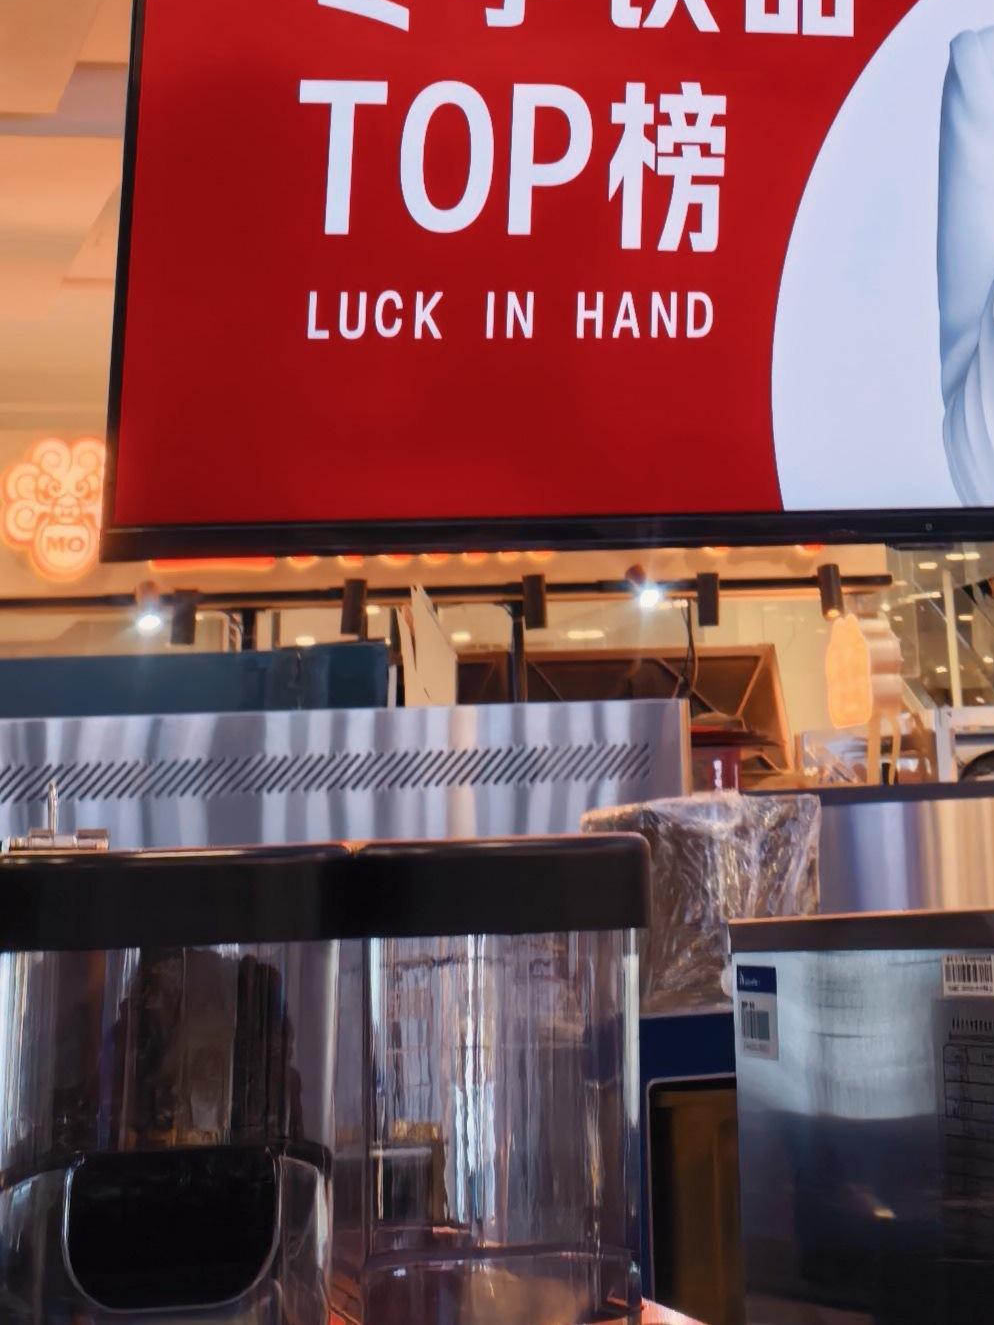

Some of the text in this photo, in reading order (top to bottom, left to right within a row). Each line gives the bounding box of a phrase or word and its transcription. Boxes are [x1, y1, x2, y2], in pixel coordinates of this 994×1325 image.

[299, 79, 728, 253] TOP榜
[307, 290, 715, 341] LUCK IN HAND
